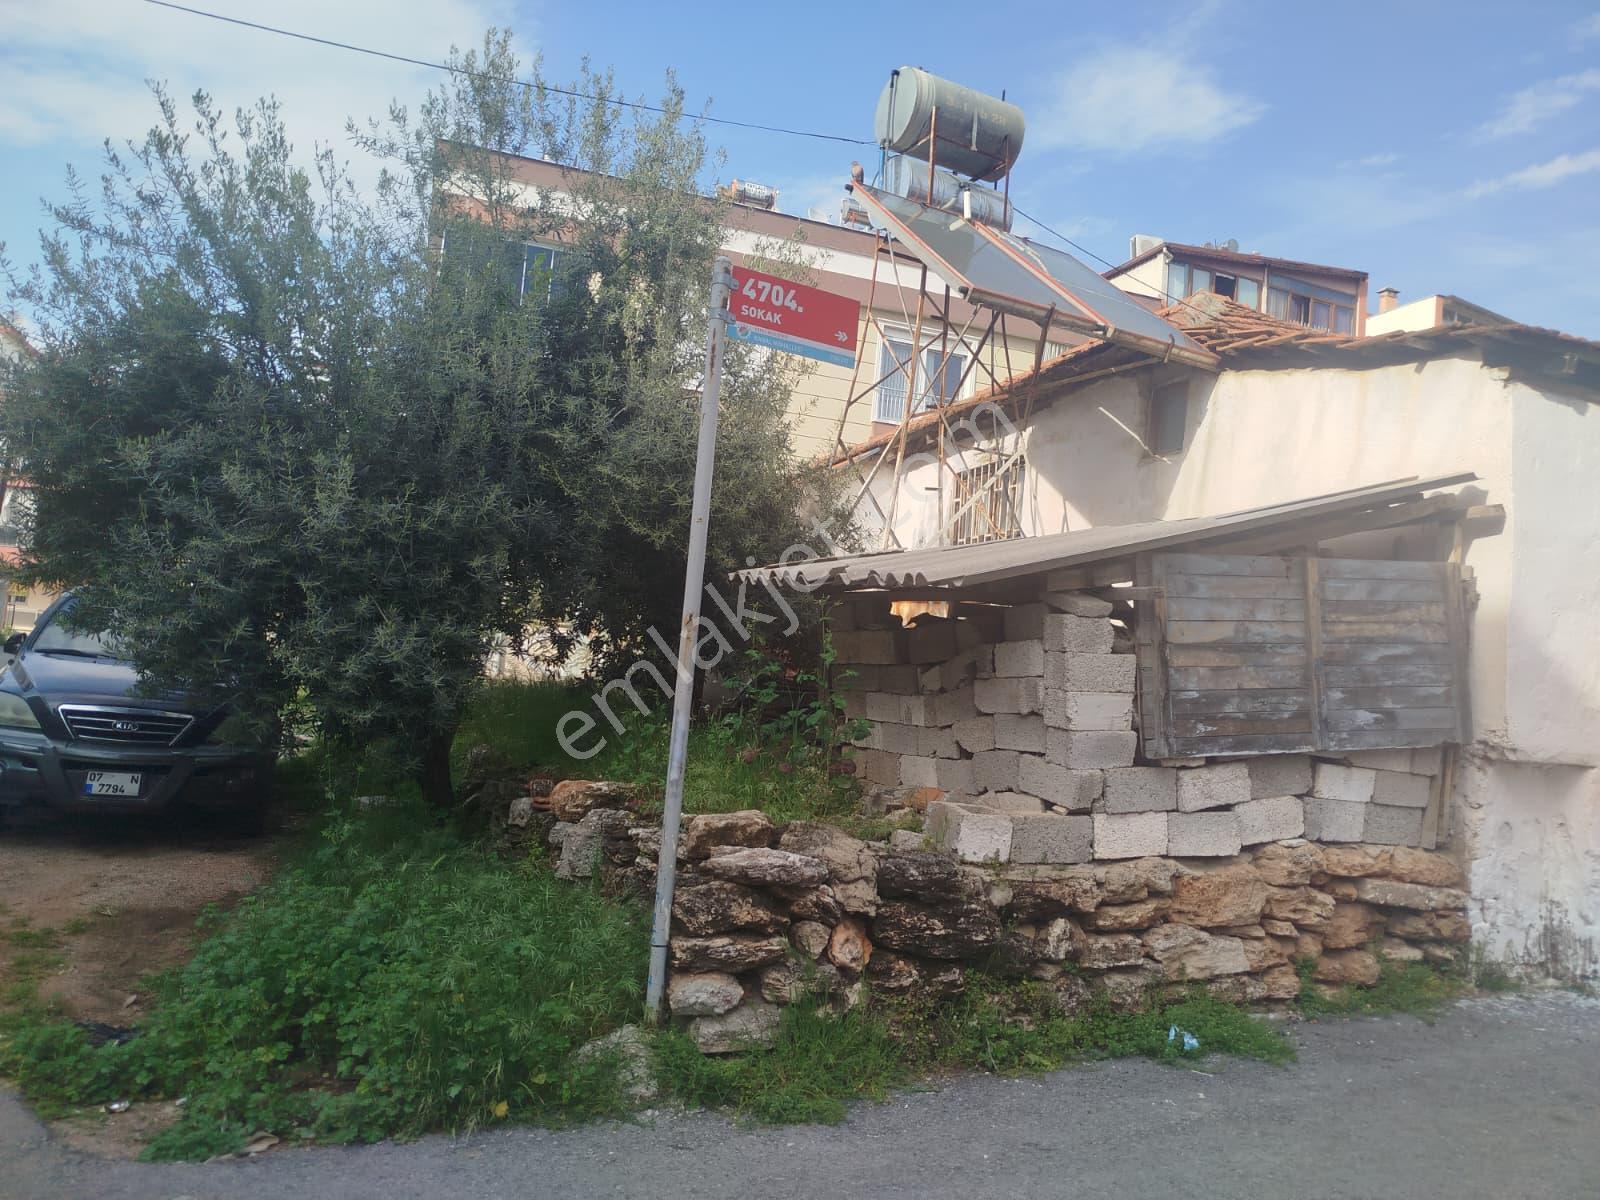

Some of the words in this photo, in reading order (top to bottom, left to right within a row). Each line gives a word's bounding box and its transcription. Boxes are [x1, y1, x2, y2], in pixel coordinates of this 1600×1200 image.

[742, 278, 804, 313] 4704.
[740, 305, 782, 325] SOKAK
[115, 722, 135, 731] KIA
[89, 772, 102, 782] 07
[130, 775, 139, 785] N
